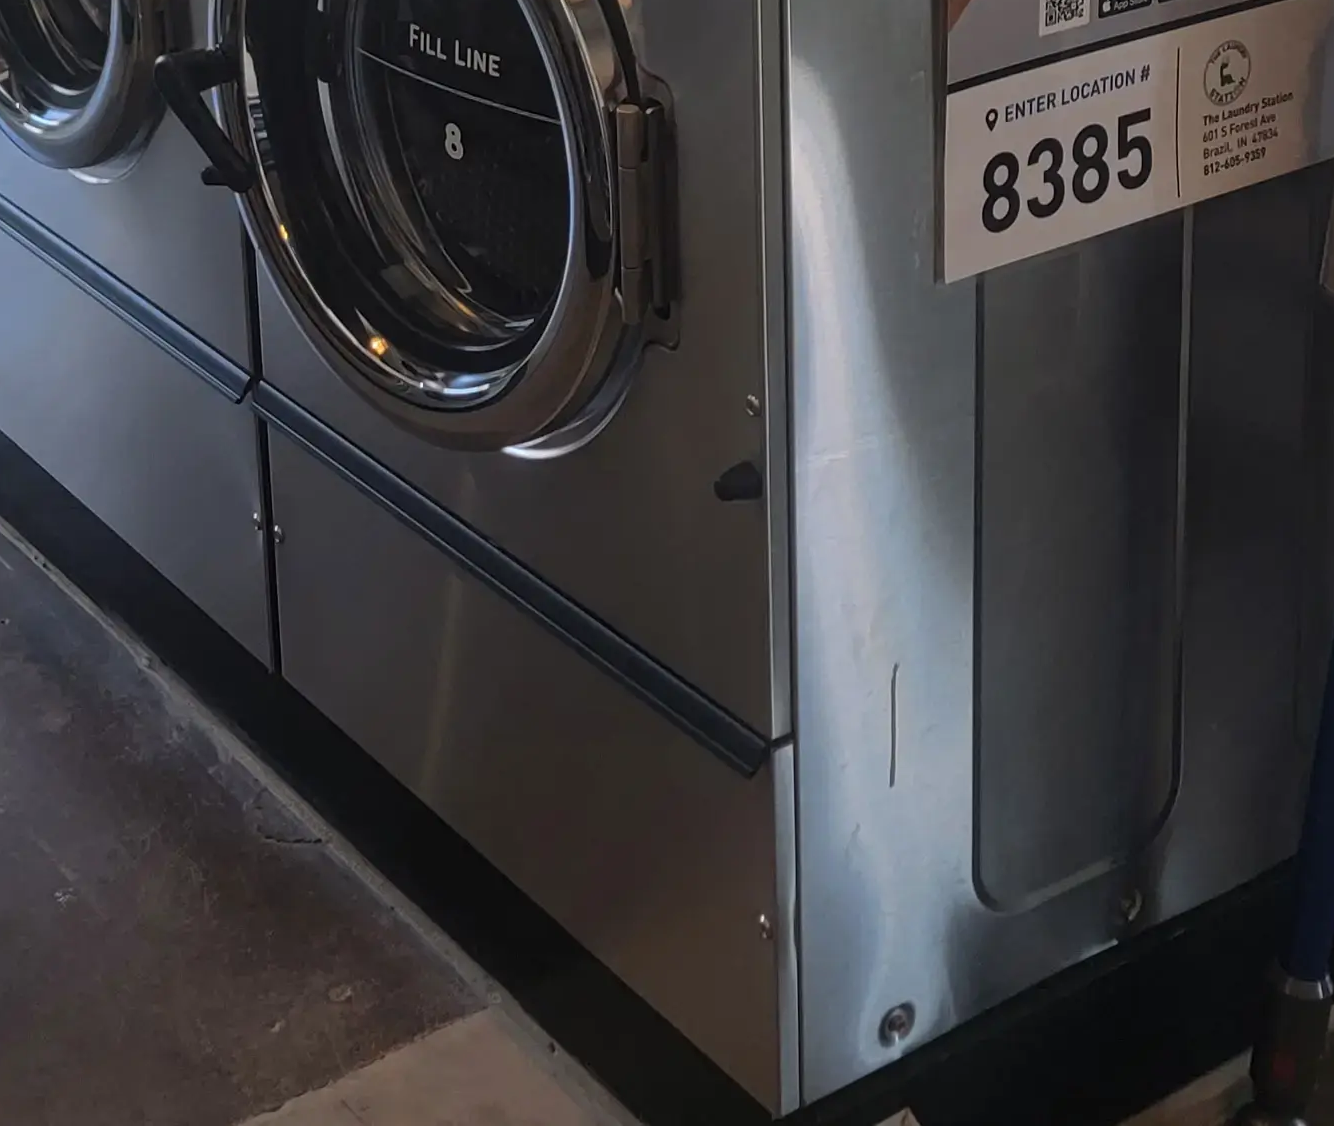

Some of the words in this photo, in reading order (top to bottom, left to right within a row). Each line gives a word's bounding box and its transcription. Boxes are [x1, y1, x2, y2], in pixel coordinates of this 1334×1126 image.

[409, 23, 447, 61] FILL
[453, 39, 502, 78] LINE
[1004, 92, 1057, 124] ENTER
[1060, 68, 1136, 106] LOCATION
[1140, 63, 1151, 83] #
[1203, 114, 1220, 127] The
[1221, 103, 1260, 122] Laundry
[1261, 91, 1295, 110] Station
[444, 122, 465, 161] 8
[1202, 128, 1218, 143] 601
[1220, 126, 1228, 138] S
[1229, 118, 1259, 135] Forest
[1259, 112, 1277, 125] Ave
[1237, 135, 1248, 149] IN
[981, 107, 1154, 234] 8385
[1202, 146, 1267, 176] 812-605-9359
